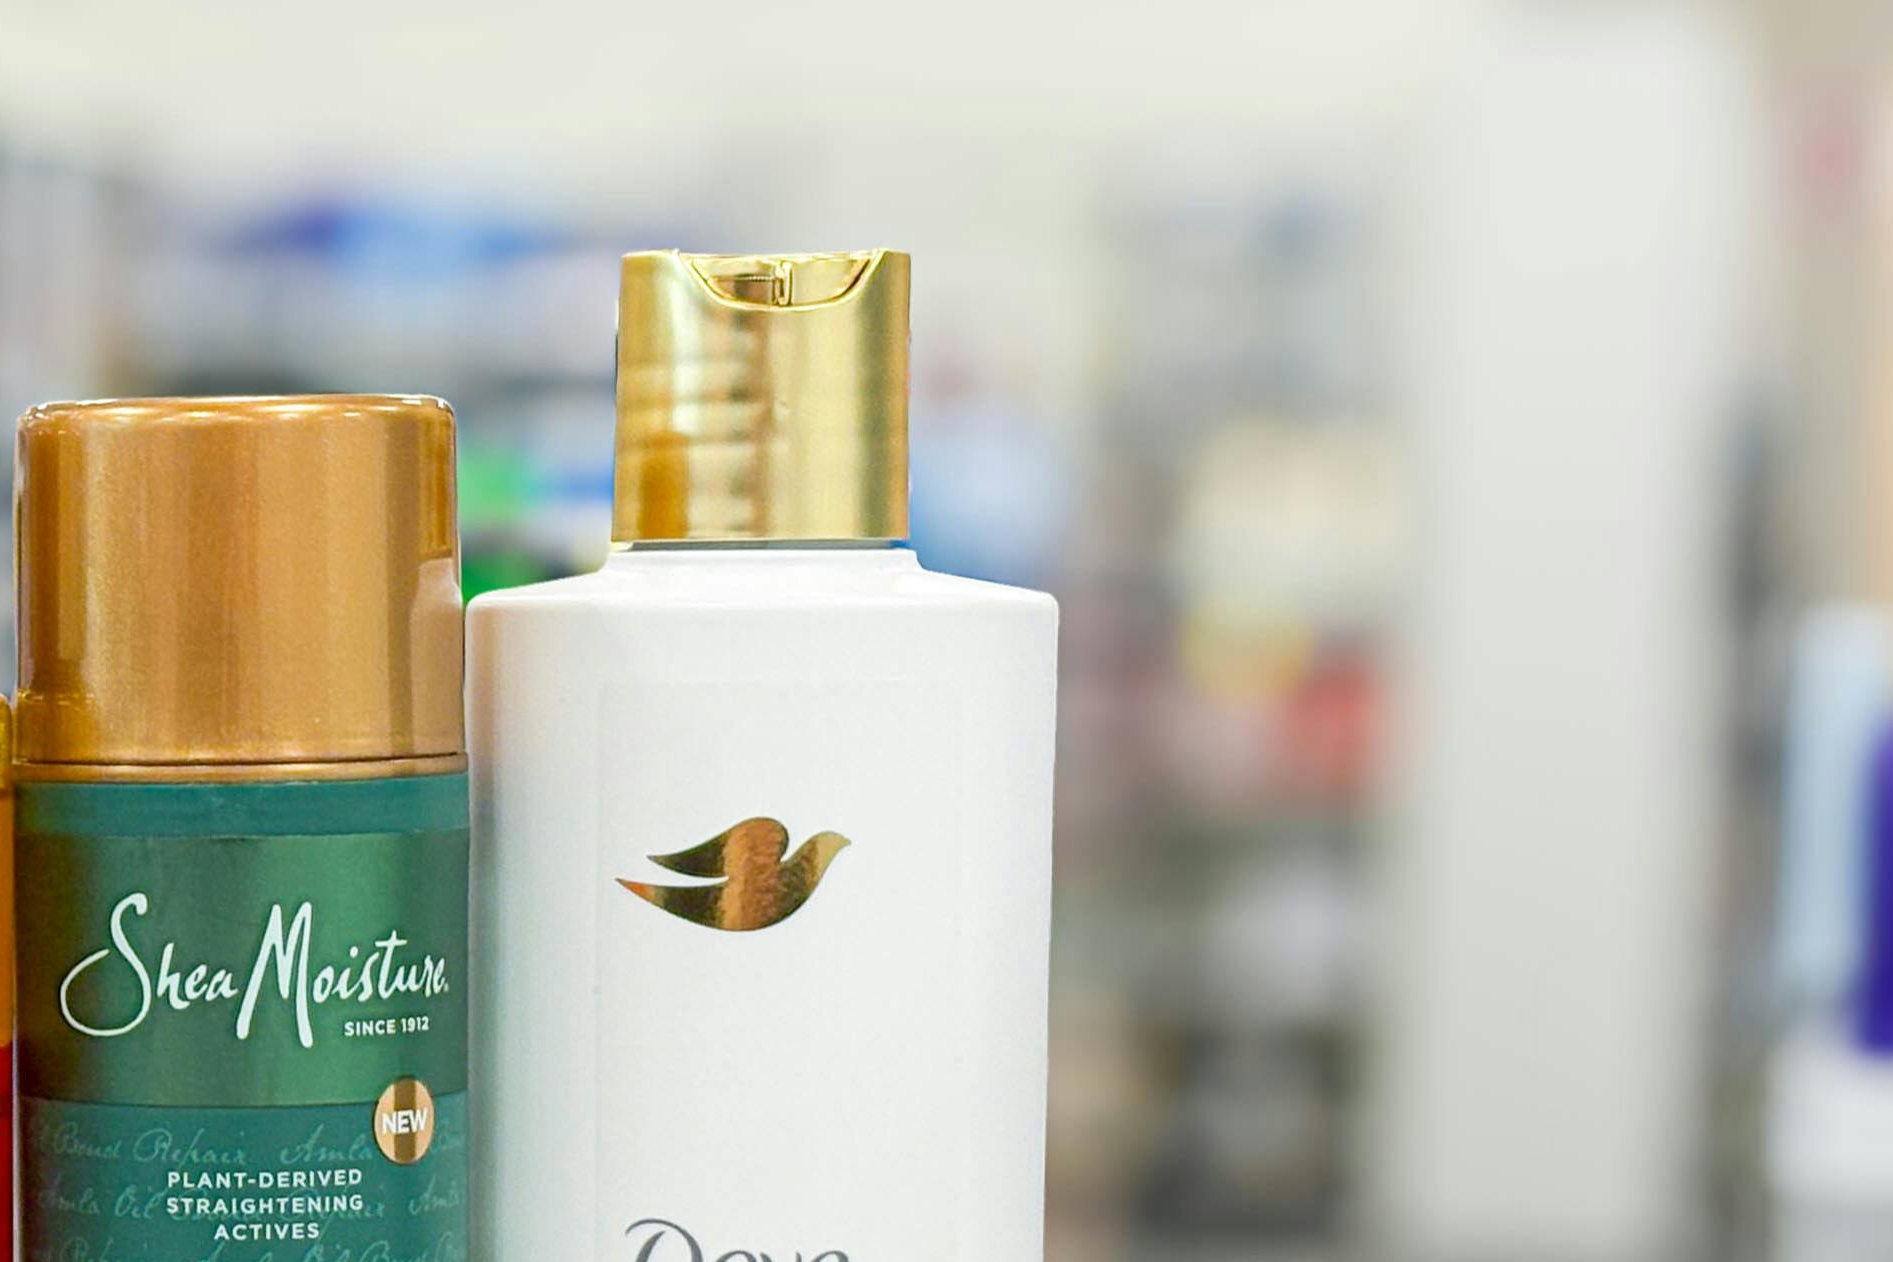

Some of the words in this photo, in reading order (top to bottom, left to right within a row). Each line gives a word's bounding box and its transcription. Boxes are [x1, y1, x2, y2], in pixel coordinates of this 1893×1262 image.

[60, 892, 239, 1036] Shea
[344, 1018, 396, 1036] SINCE
[401, 1015, 430, 1033] 1912
[381, 1107, 429, 1136] NEW
[167, 1168, 363, 1190] PLANT-DERIVED
[166, 1194, 364, 1216] STRAIGHTENING
[213, 1222, 320, 1241] ACTIVES
